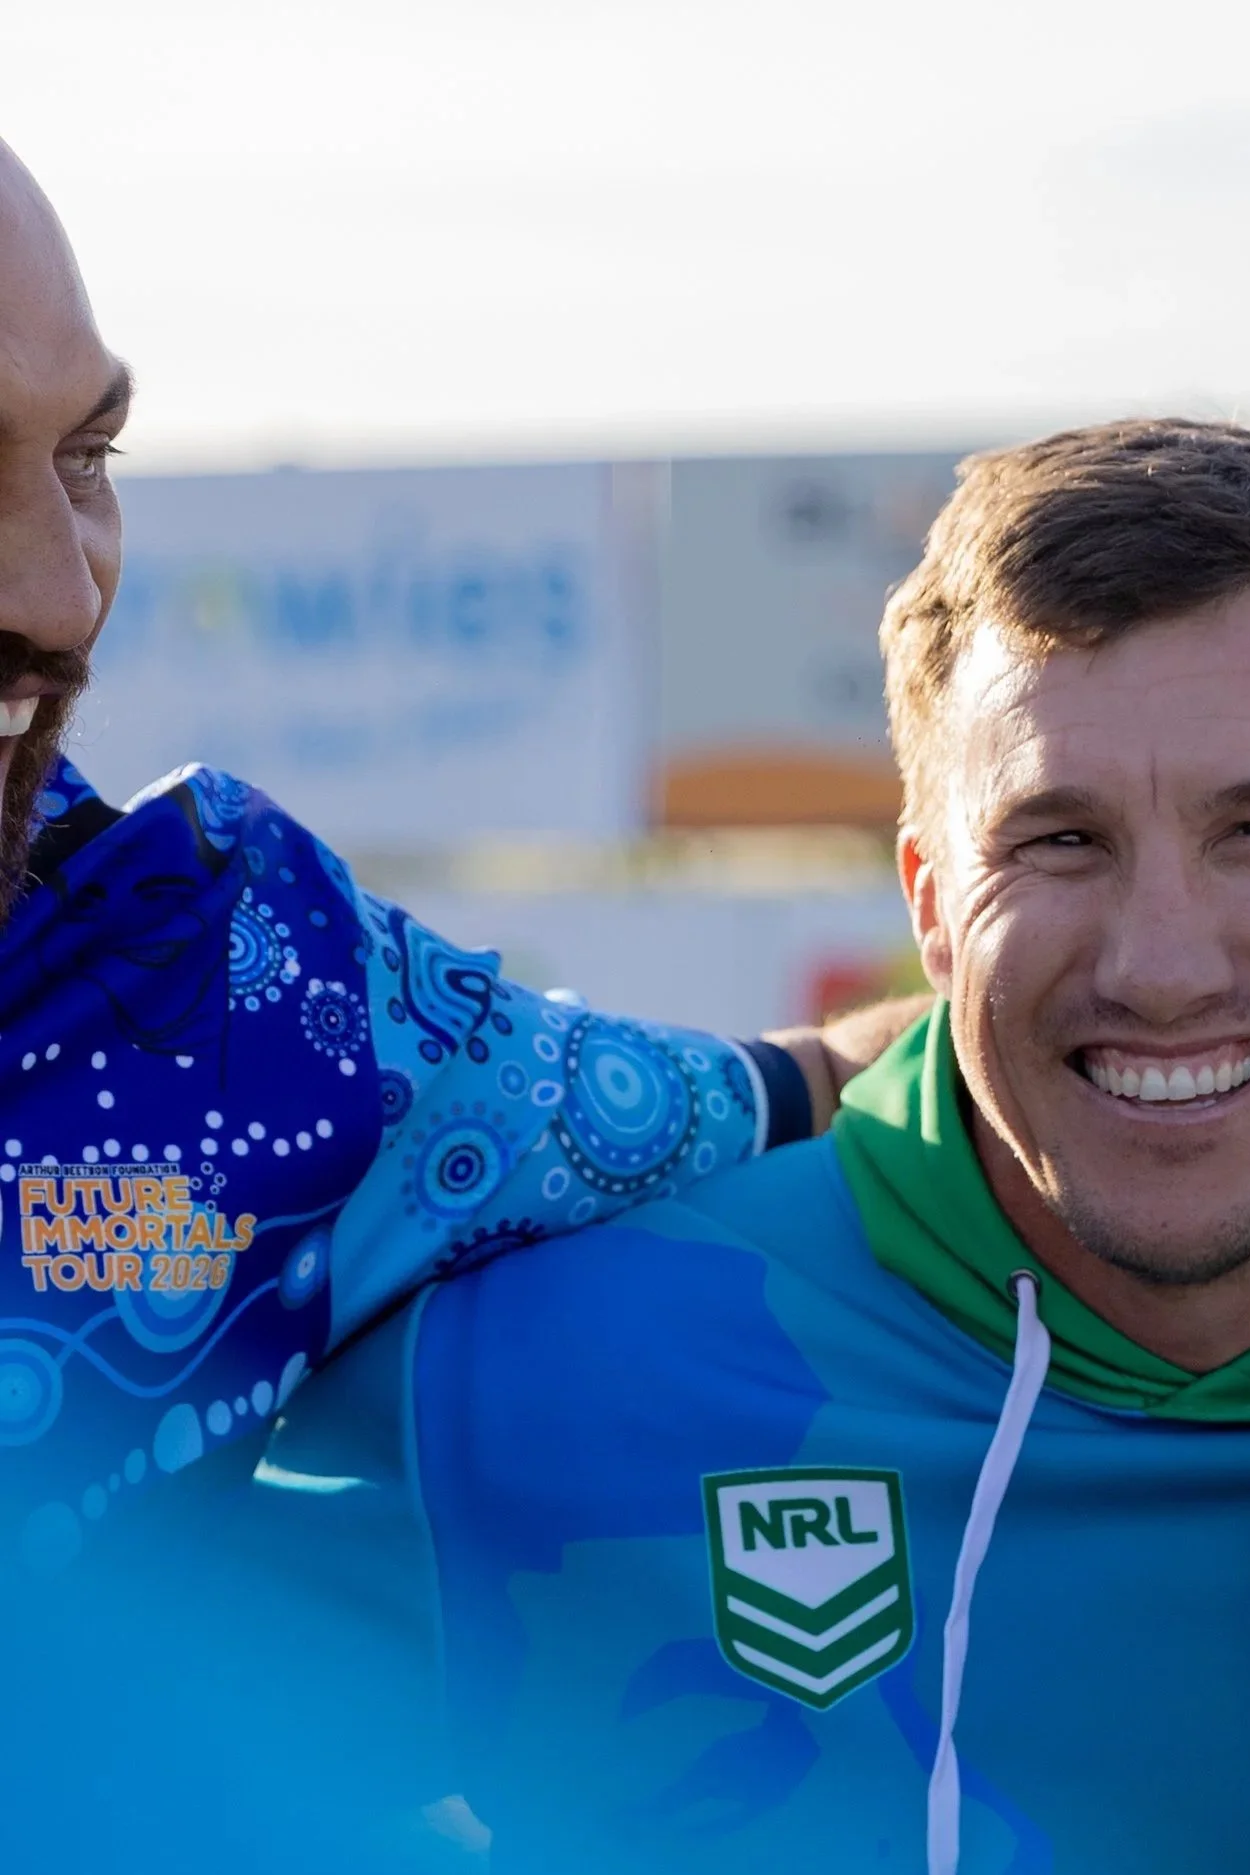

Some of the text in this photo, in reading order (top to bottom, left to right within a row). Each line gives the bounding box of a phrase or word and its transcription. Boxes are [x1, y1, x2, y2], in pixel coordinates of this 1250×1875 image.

[20, 1164, 60, 1176] ARTHUR
[112, 1164, 178, 1175] FOUNDATION
[20, 1177, 191, 1214] FUTURE
[23, 1213, 256, 1252] IMMORTALS
[23, 1255, 230, 1290] TOUR 2026
[738, 1496, 878, 1552] NRL
